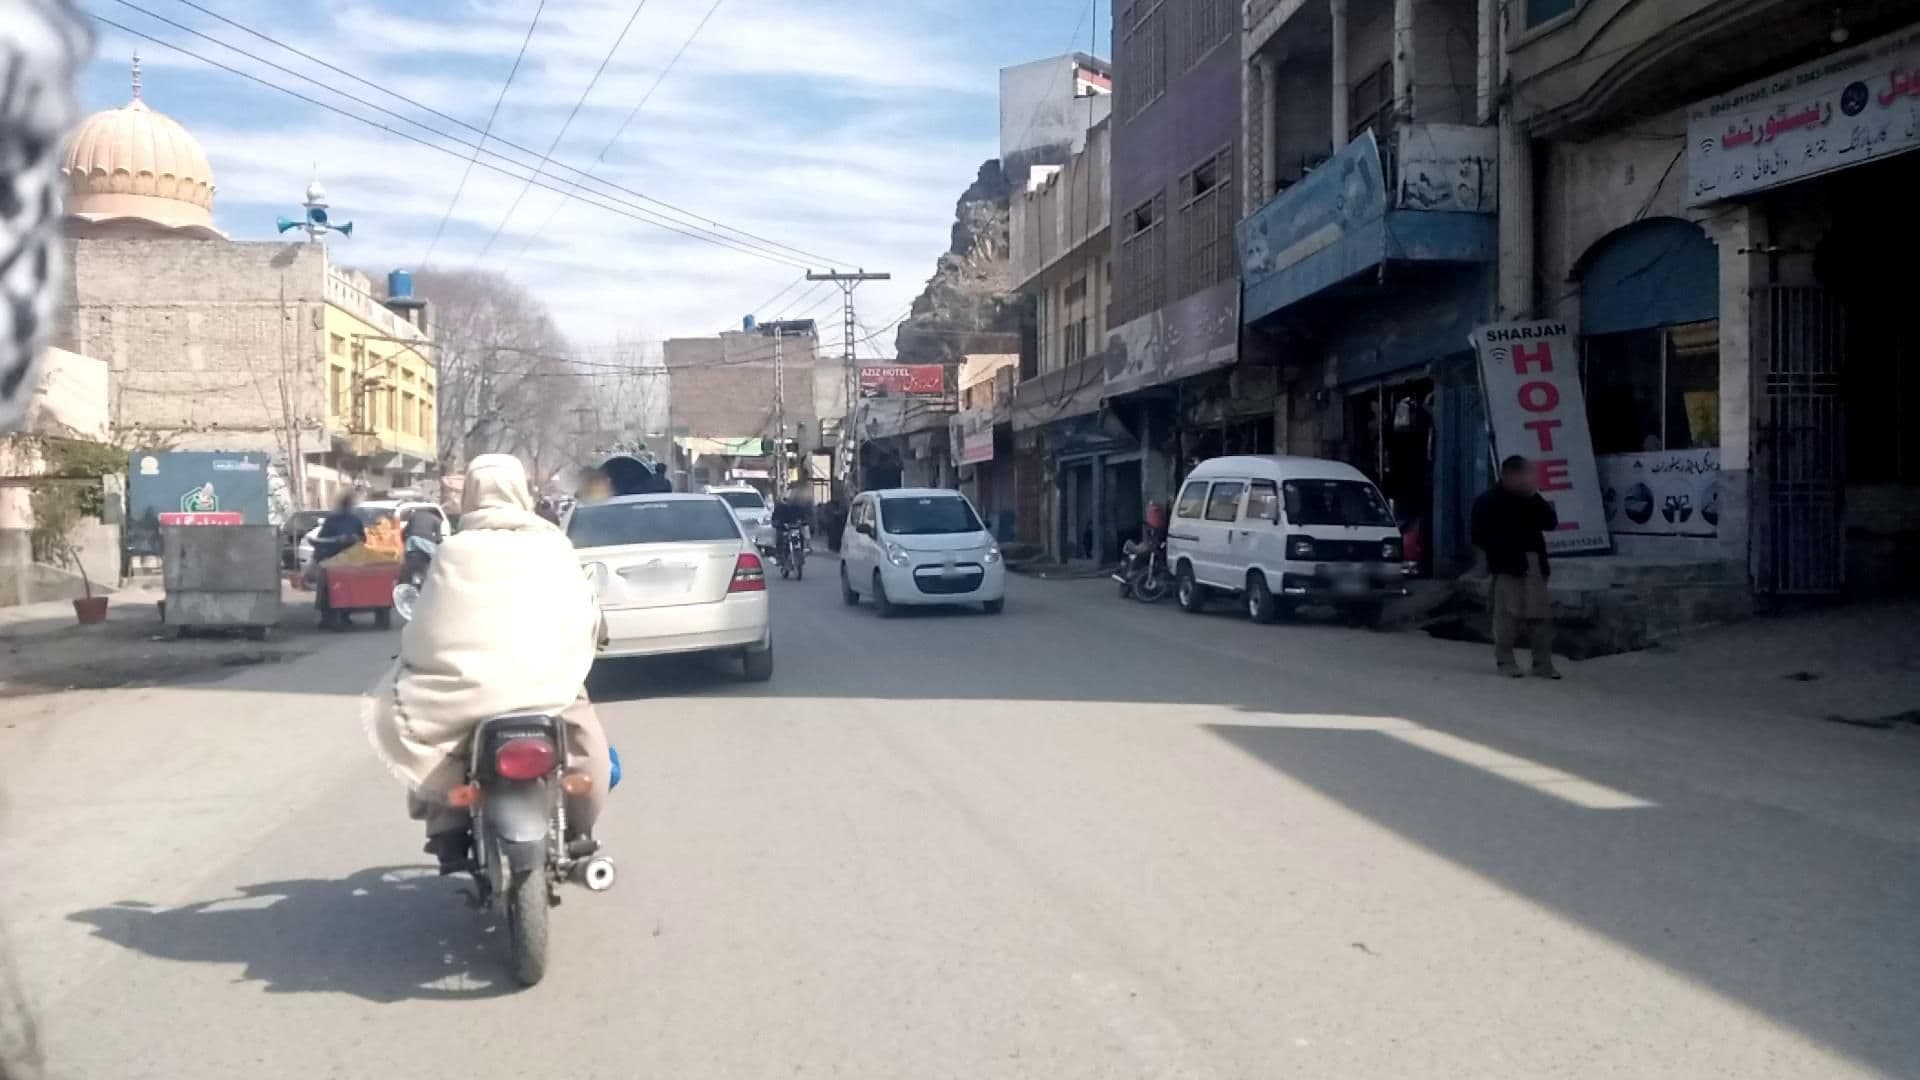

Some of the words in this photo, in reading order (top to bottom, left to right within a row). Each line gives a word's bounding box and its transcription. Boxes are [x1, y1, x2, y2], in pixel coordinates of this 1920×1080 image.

[1720, 98, 1833, 149] ریسٹورنٹ
[1487, 323, 1567, 342] SHARJAH
[861, 368, 881, 377] AZIZ
[883, 367, 910, 377] HOTEL
